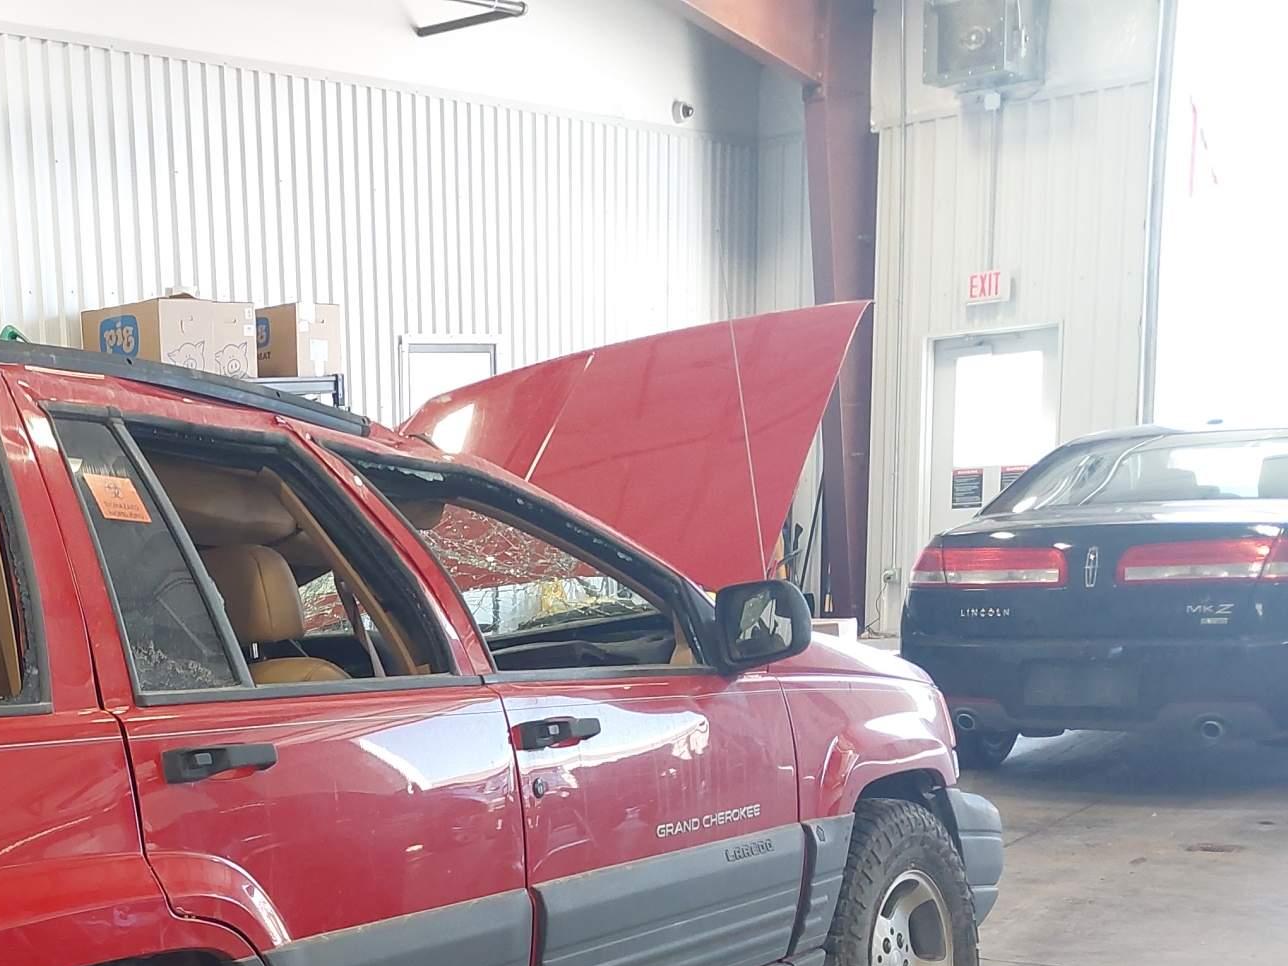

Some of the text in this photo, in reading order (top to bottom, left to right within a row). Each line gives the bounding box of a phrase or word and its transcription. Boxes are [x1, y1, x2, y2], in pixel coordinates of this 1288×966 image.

[969, 271, 1001, 299] EXIT
[103, 321, 135, 354] pig
[960, 607, 1010, 617] LINCOLN
[656, 803, 761, 839] GRAND CHEROKEE
[725, 839, 775, 862] LAREDO
